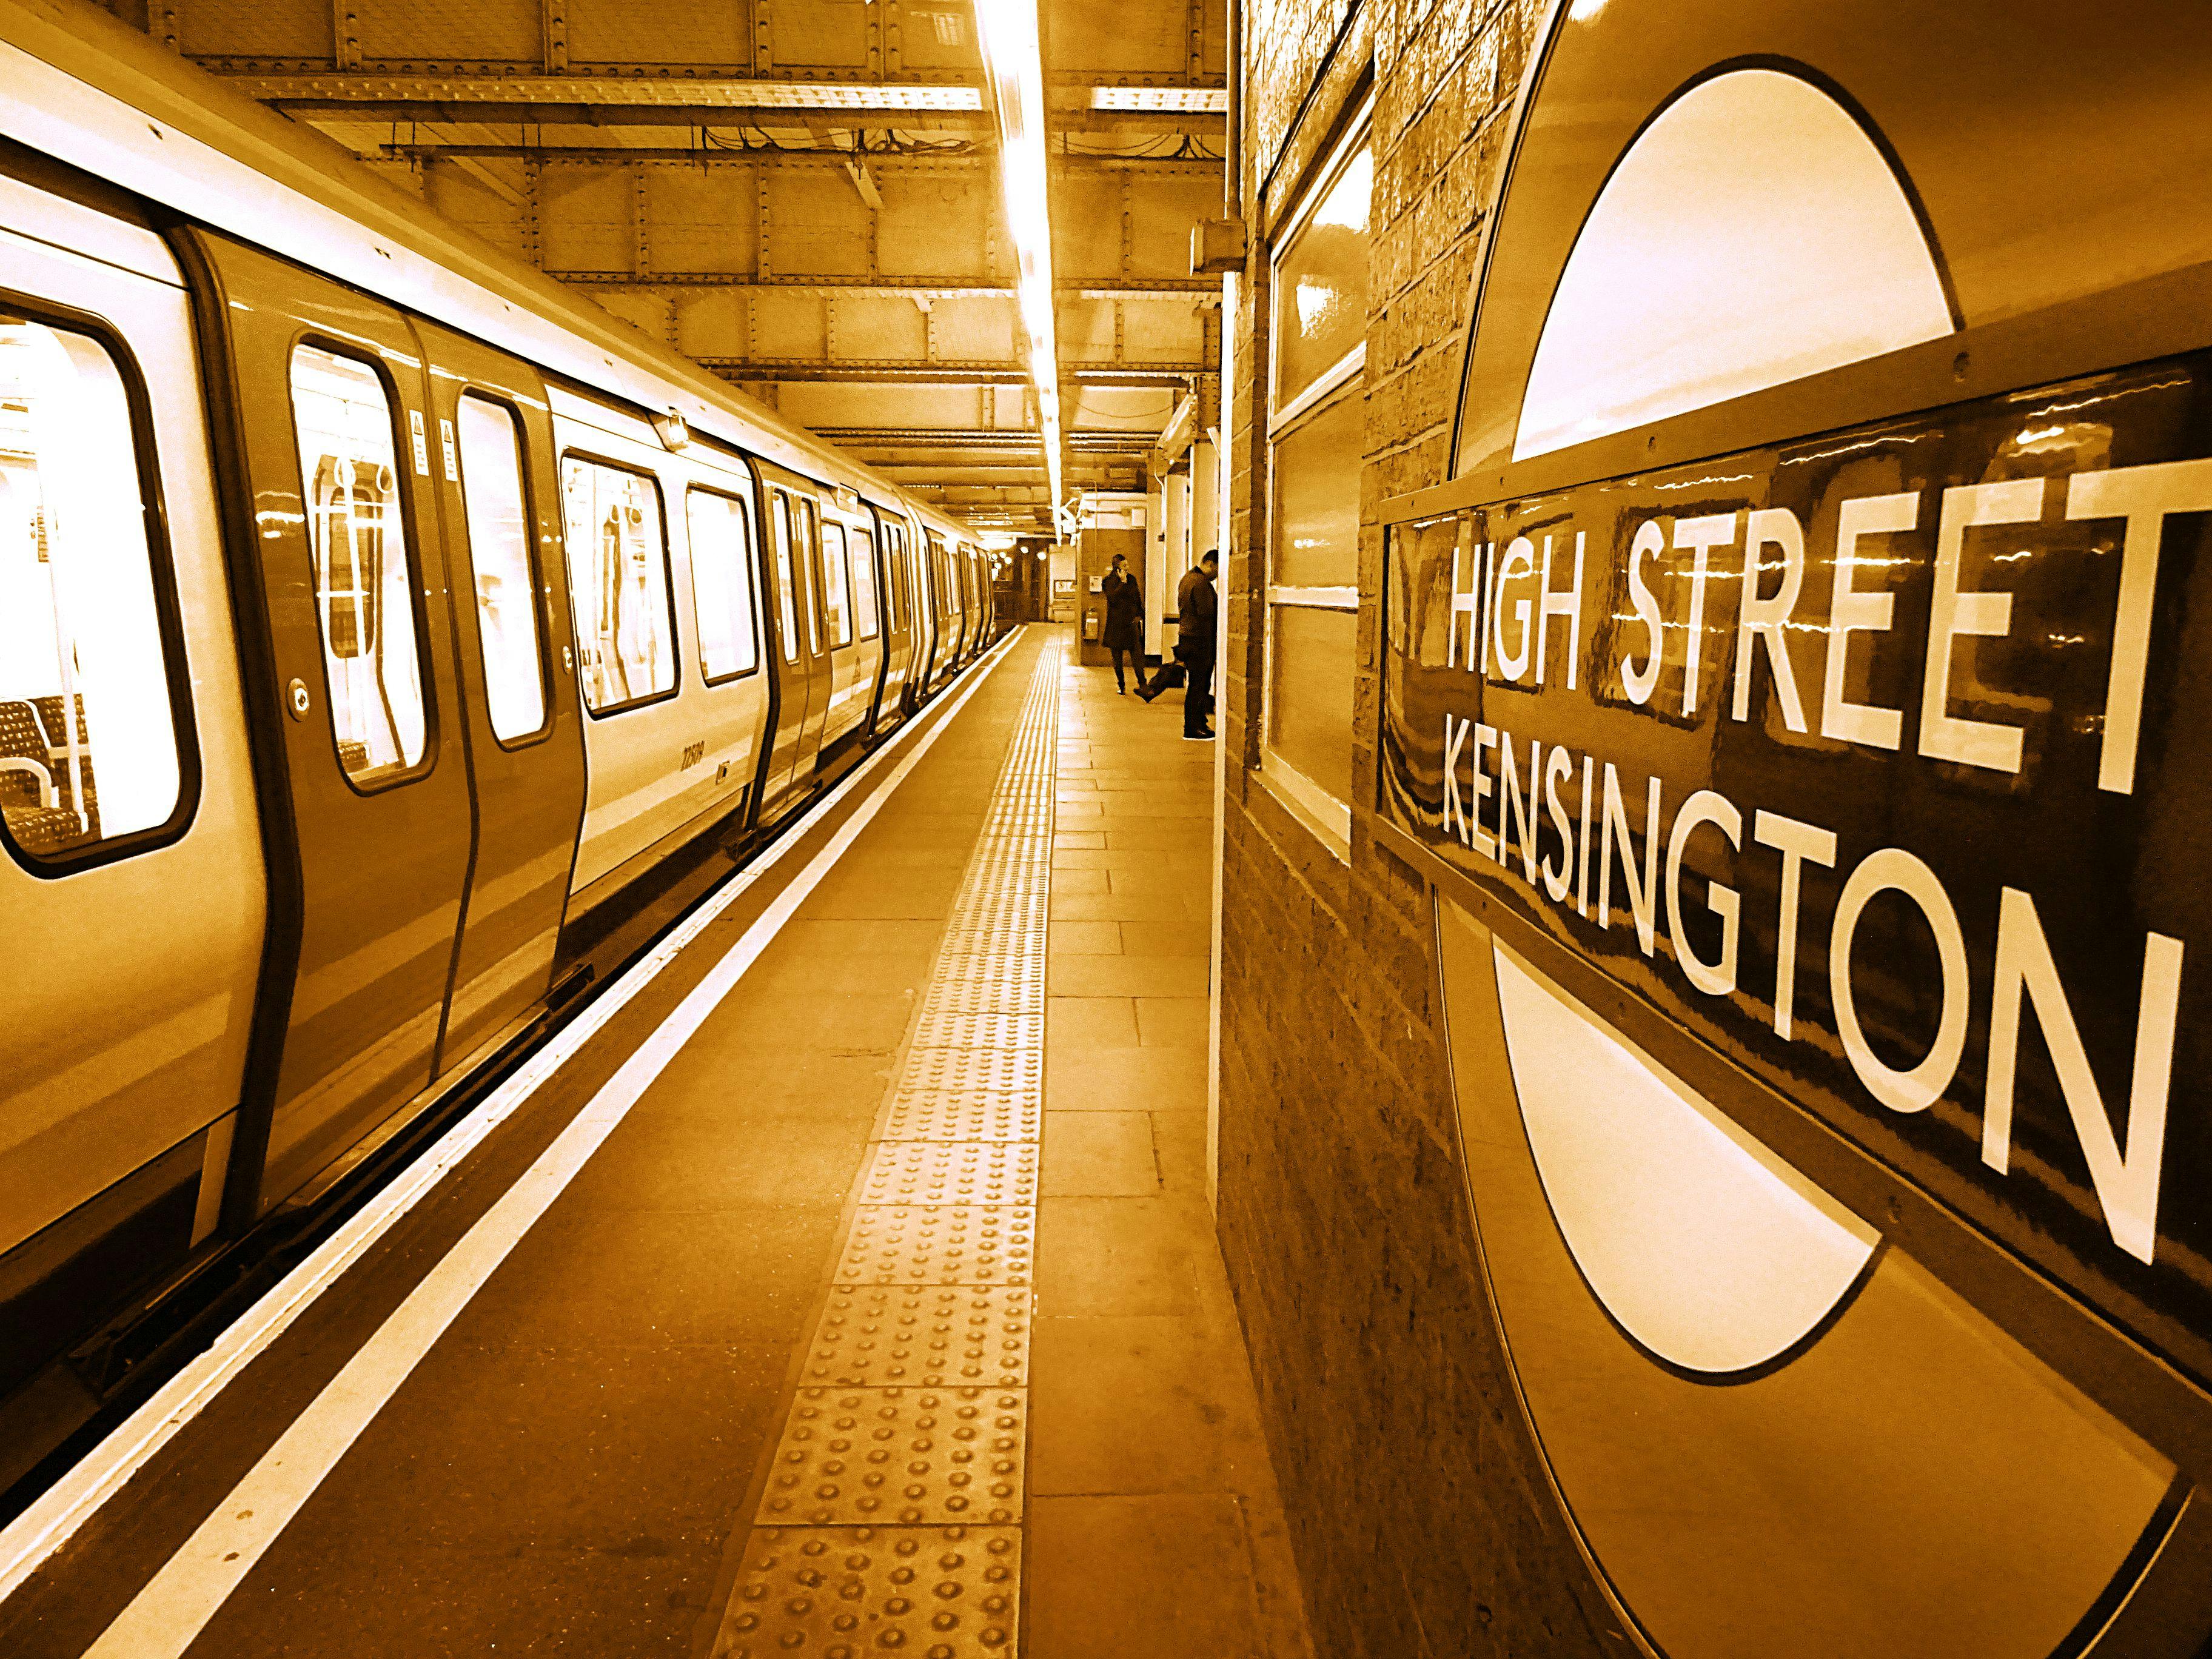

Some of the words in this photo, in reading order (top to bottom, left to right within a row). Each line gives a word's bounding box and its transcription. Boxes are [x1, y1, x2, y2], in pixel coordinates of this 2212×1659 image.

[1445, 531, 1586, 690] HIGH
[1621, 458, 2212, 796] STREET
[1443, 712, 2184, 1265] KENSINGTON
